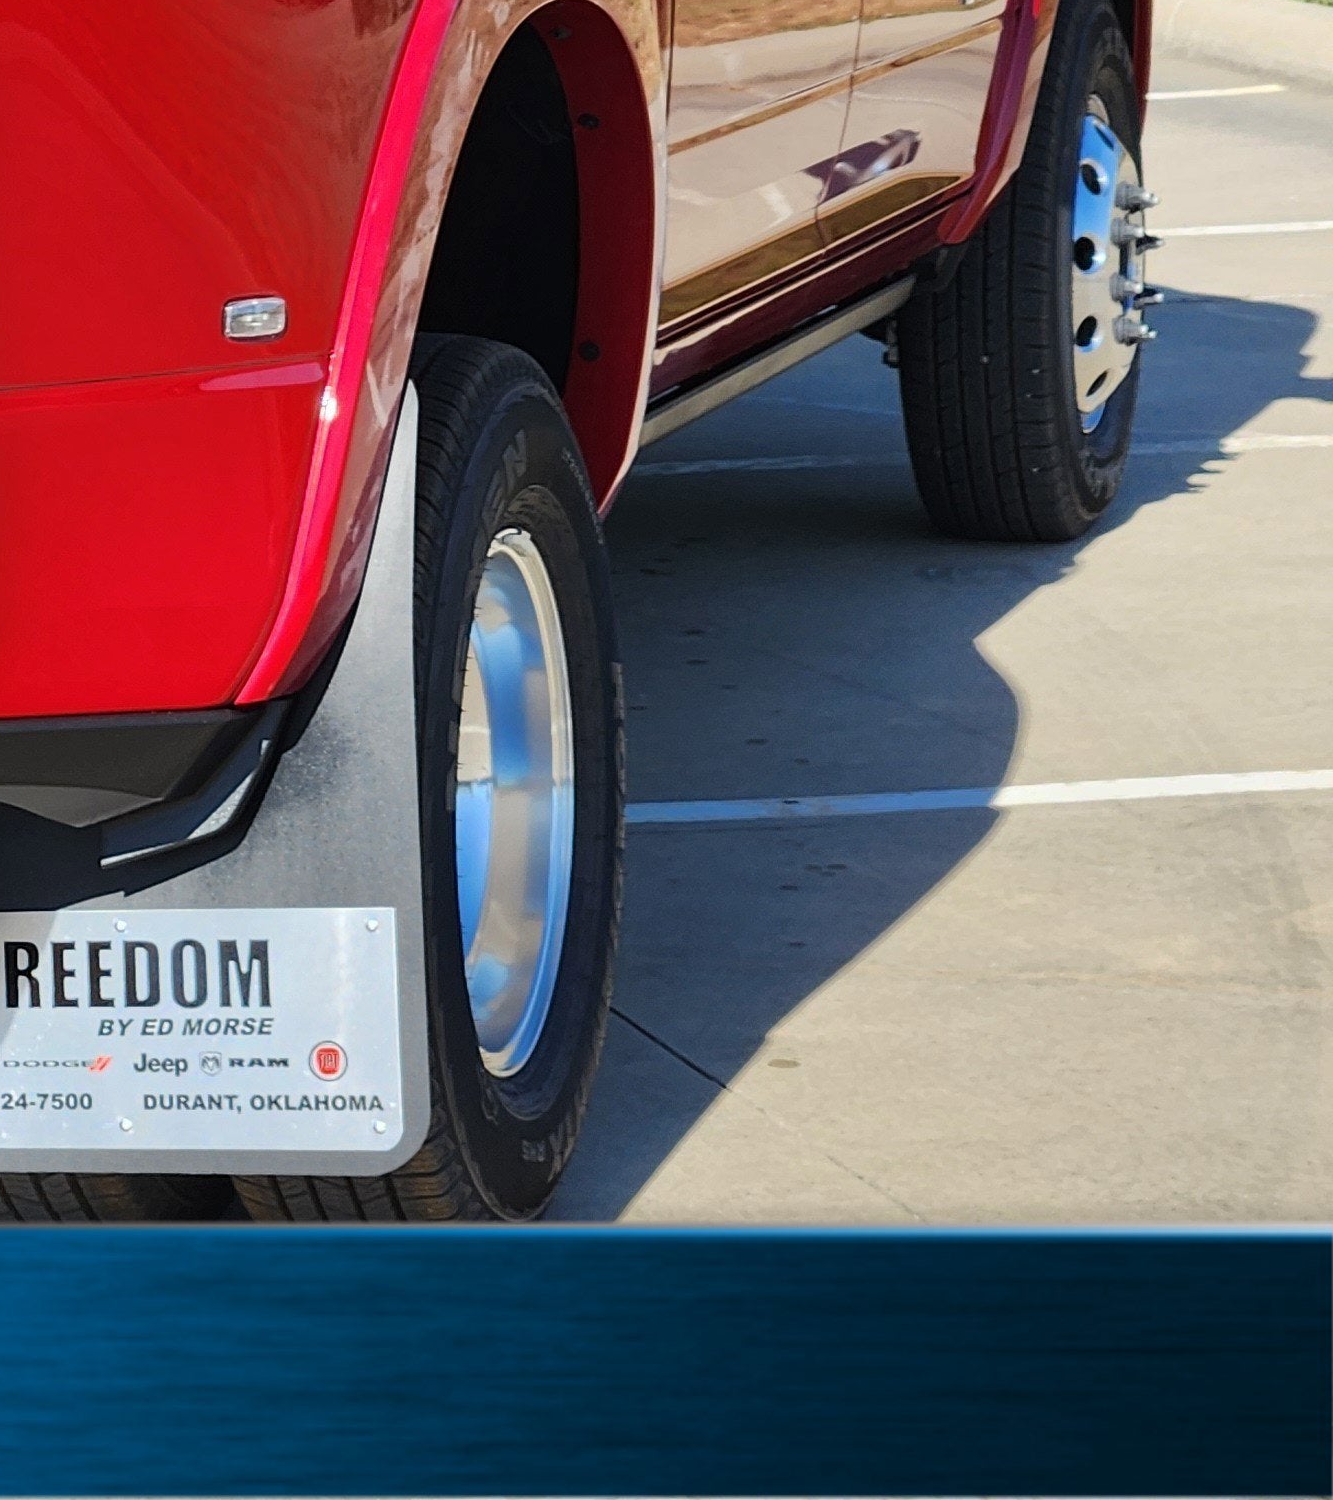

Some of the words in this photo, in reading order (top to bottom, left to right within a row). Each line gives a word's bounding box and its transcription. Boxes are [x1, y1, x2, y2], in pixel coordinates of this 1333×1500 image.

[97, 1018, 134, 1037] BY
[139, 1018, 175, 1037] ED
[180, 1018, 275, 1037] MORSE
[132, 1052, 189, 1077] Jeep
[228, 1057, 290, 1069] RAM
[142, 1093, 244, 1115] DURANT,
[249, 1094, 385, 1112] OKLAHOMA
